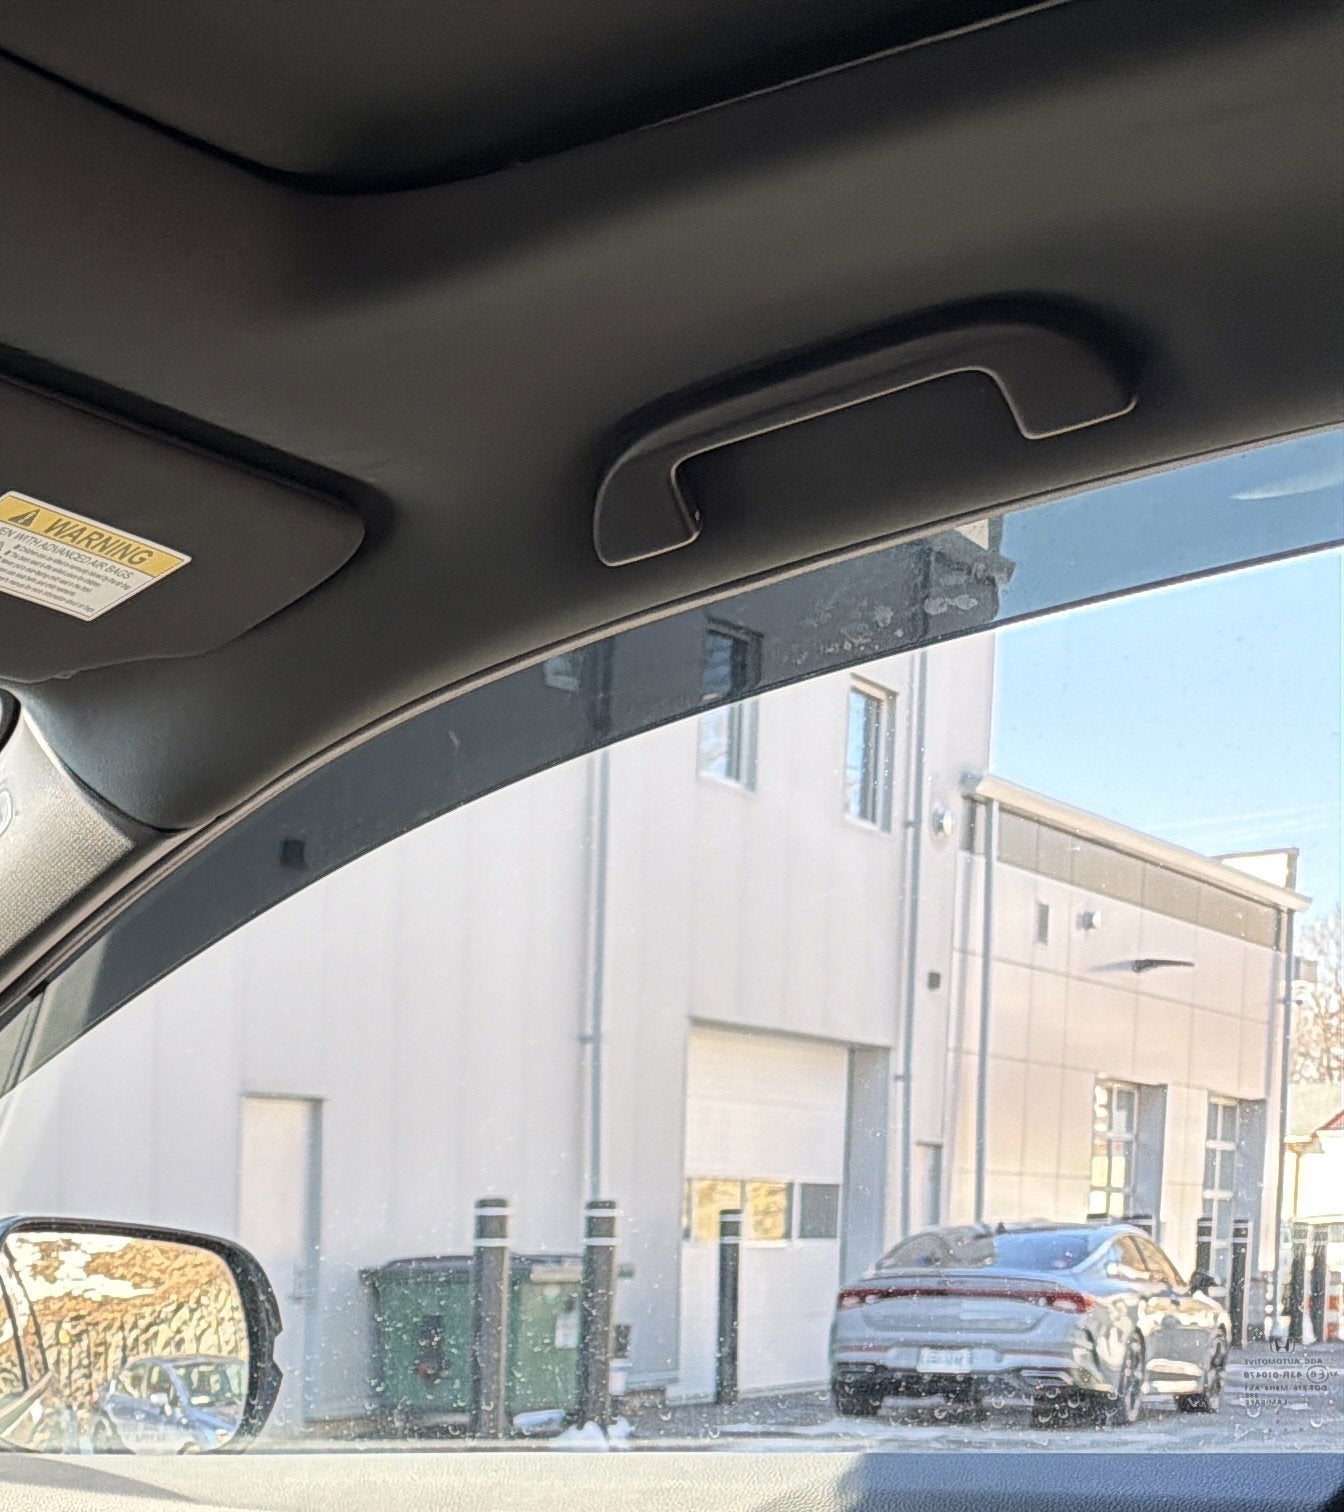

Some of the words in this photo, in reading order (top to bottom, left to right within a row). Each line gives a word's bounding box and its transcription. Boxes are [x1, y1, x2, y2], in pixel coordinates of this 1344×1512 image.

[14, 532, 42, 547] WITH
[40, 539, 93, 565] ADVANCED
[87, 556, 111, 571] AIR
[105, 563, 136, 580] BAGS
[44, 518, 154, 566] WARNING
